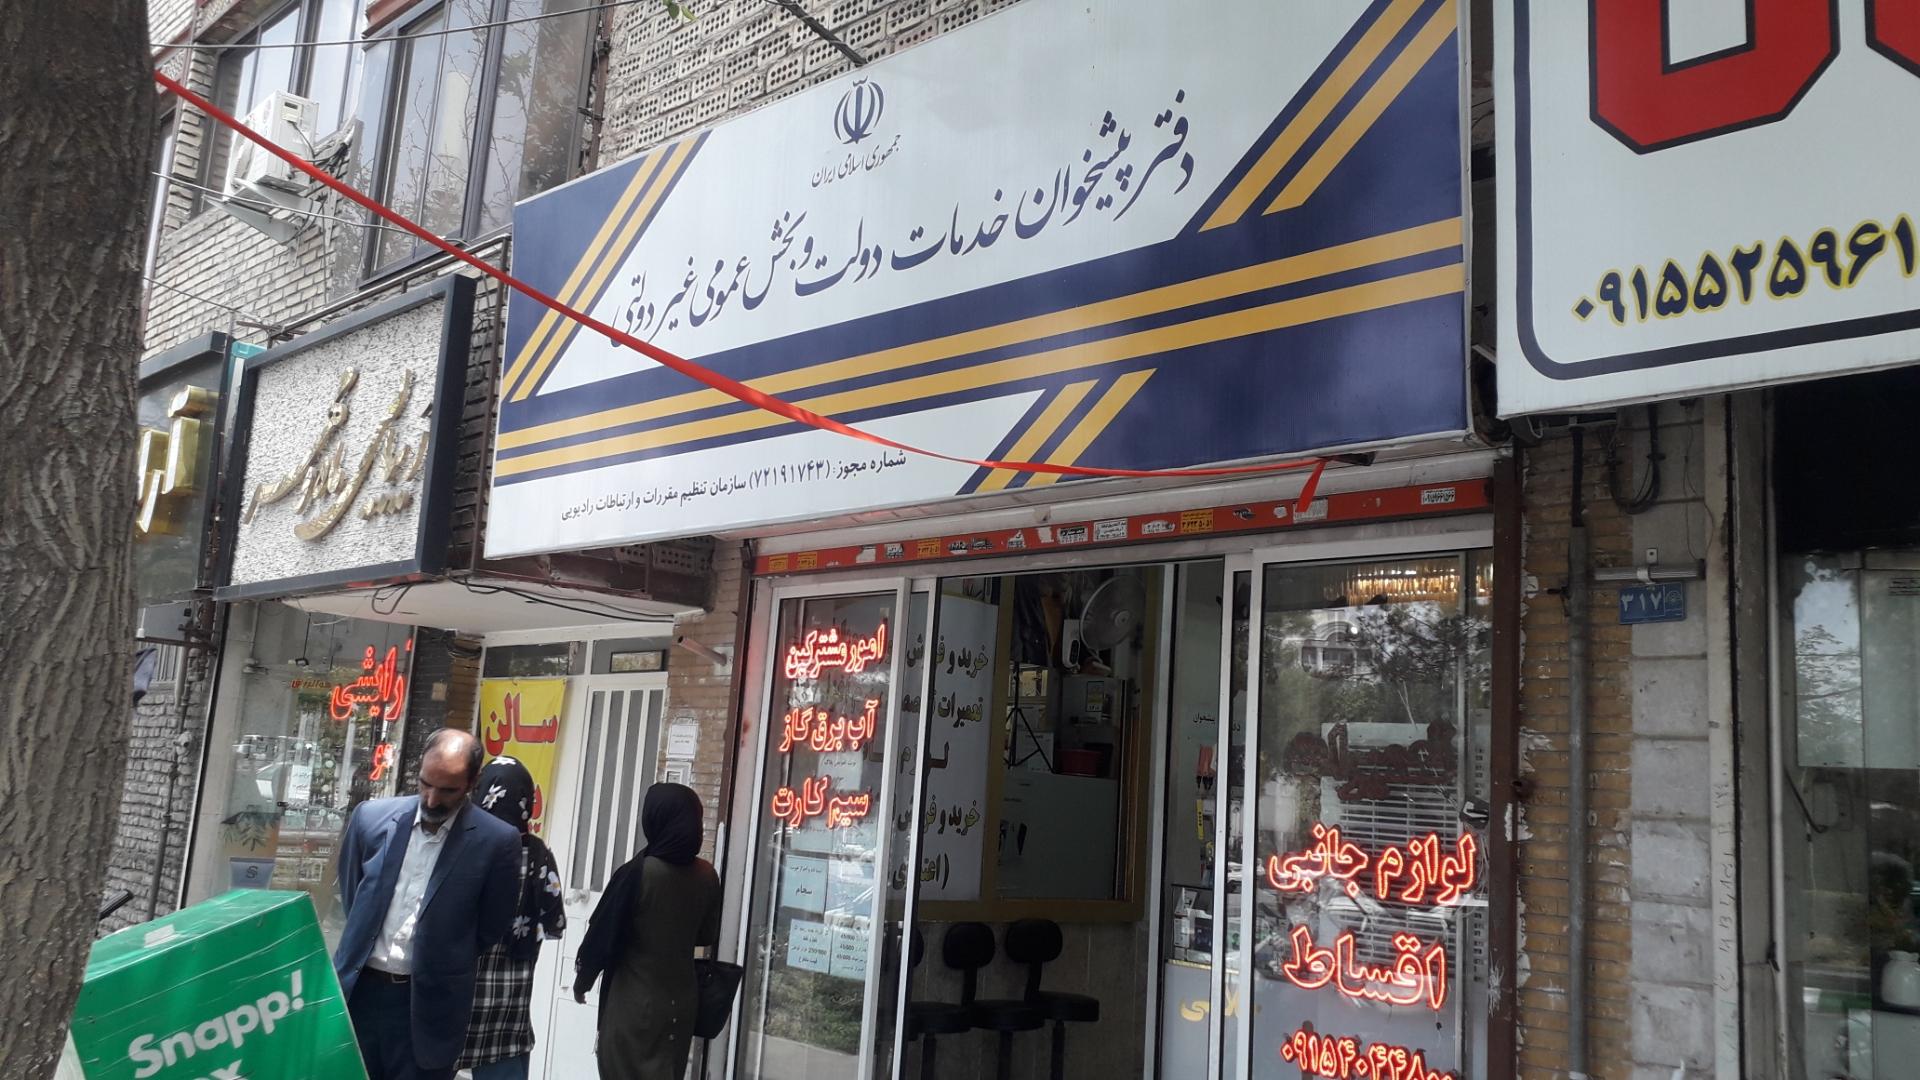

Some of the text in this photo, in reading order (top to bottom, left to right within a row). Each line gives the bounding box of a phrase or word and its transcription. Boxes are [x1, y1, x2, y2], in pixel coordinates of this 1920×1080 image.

[811, 134, 901, 188] جمهوری اسلامی ایران
[1014, 110, 1133, 240] پیشخوان
[1113, 89, 1195, 222] دفتر
[795, 215, 883, 297] دولت
[890, 188, 1009, 271] خدمات
[742, 210, 808, 311] بخش
[610, 270, 655, 348] دولتی
[647, 255, 698, 344] غیر
[689, 255, 751, 328] عمومی
[709, 474, 747, 497] سازمان
[870, 450, 907, 474] شماره
[561, 498, 594, 521] رادیویی
[595, 490, 635, 512] ارتباطات
[643, 487, 679, 506] مقررات
[680, 481, 708, 507] تنظیم
[331, 639, 412, 721] رایشی
[785, 624, 885, 679] امور مشترکین
[957, 644, 989, 679] خرید
[485, 692, 559, 757] سالن
[780, 700, 879, 751] آب برق گاز
[773, 776, 869, 828] سیم کارت
[948, 800, 981, 836] خرید
[1269, 822, 1477, 906] لوازم جانبی
[1282, 926, 1446, 1011] اقساط
[128, 969, 305, 1079] Snapp!
[1282, 1031, 1453, 1080] ۰۹۱۵۴۰۴۴۸
